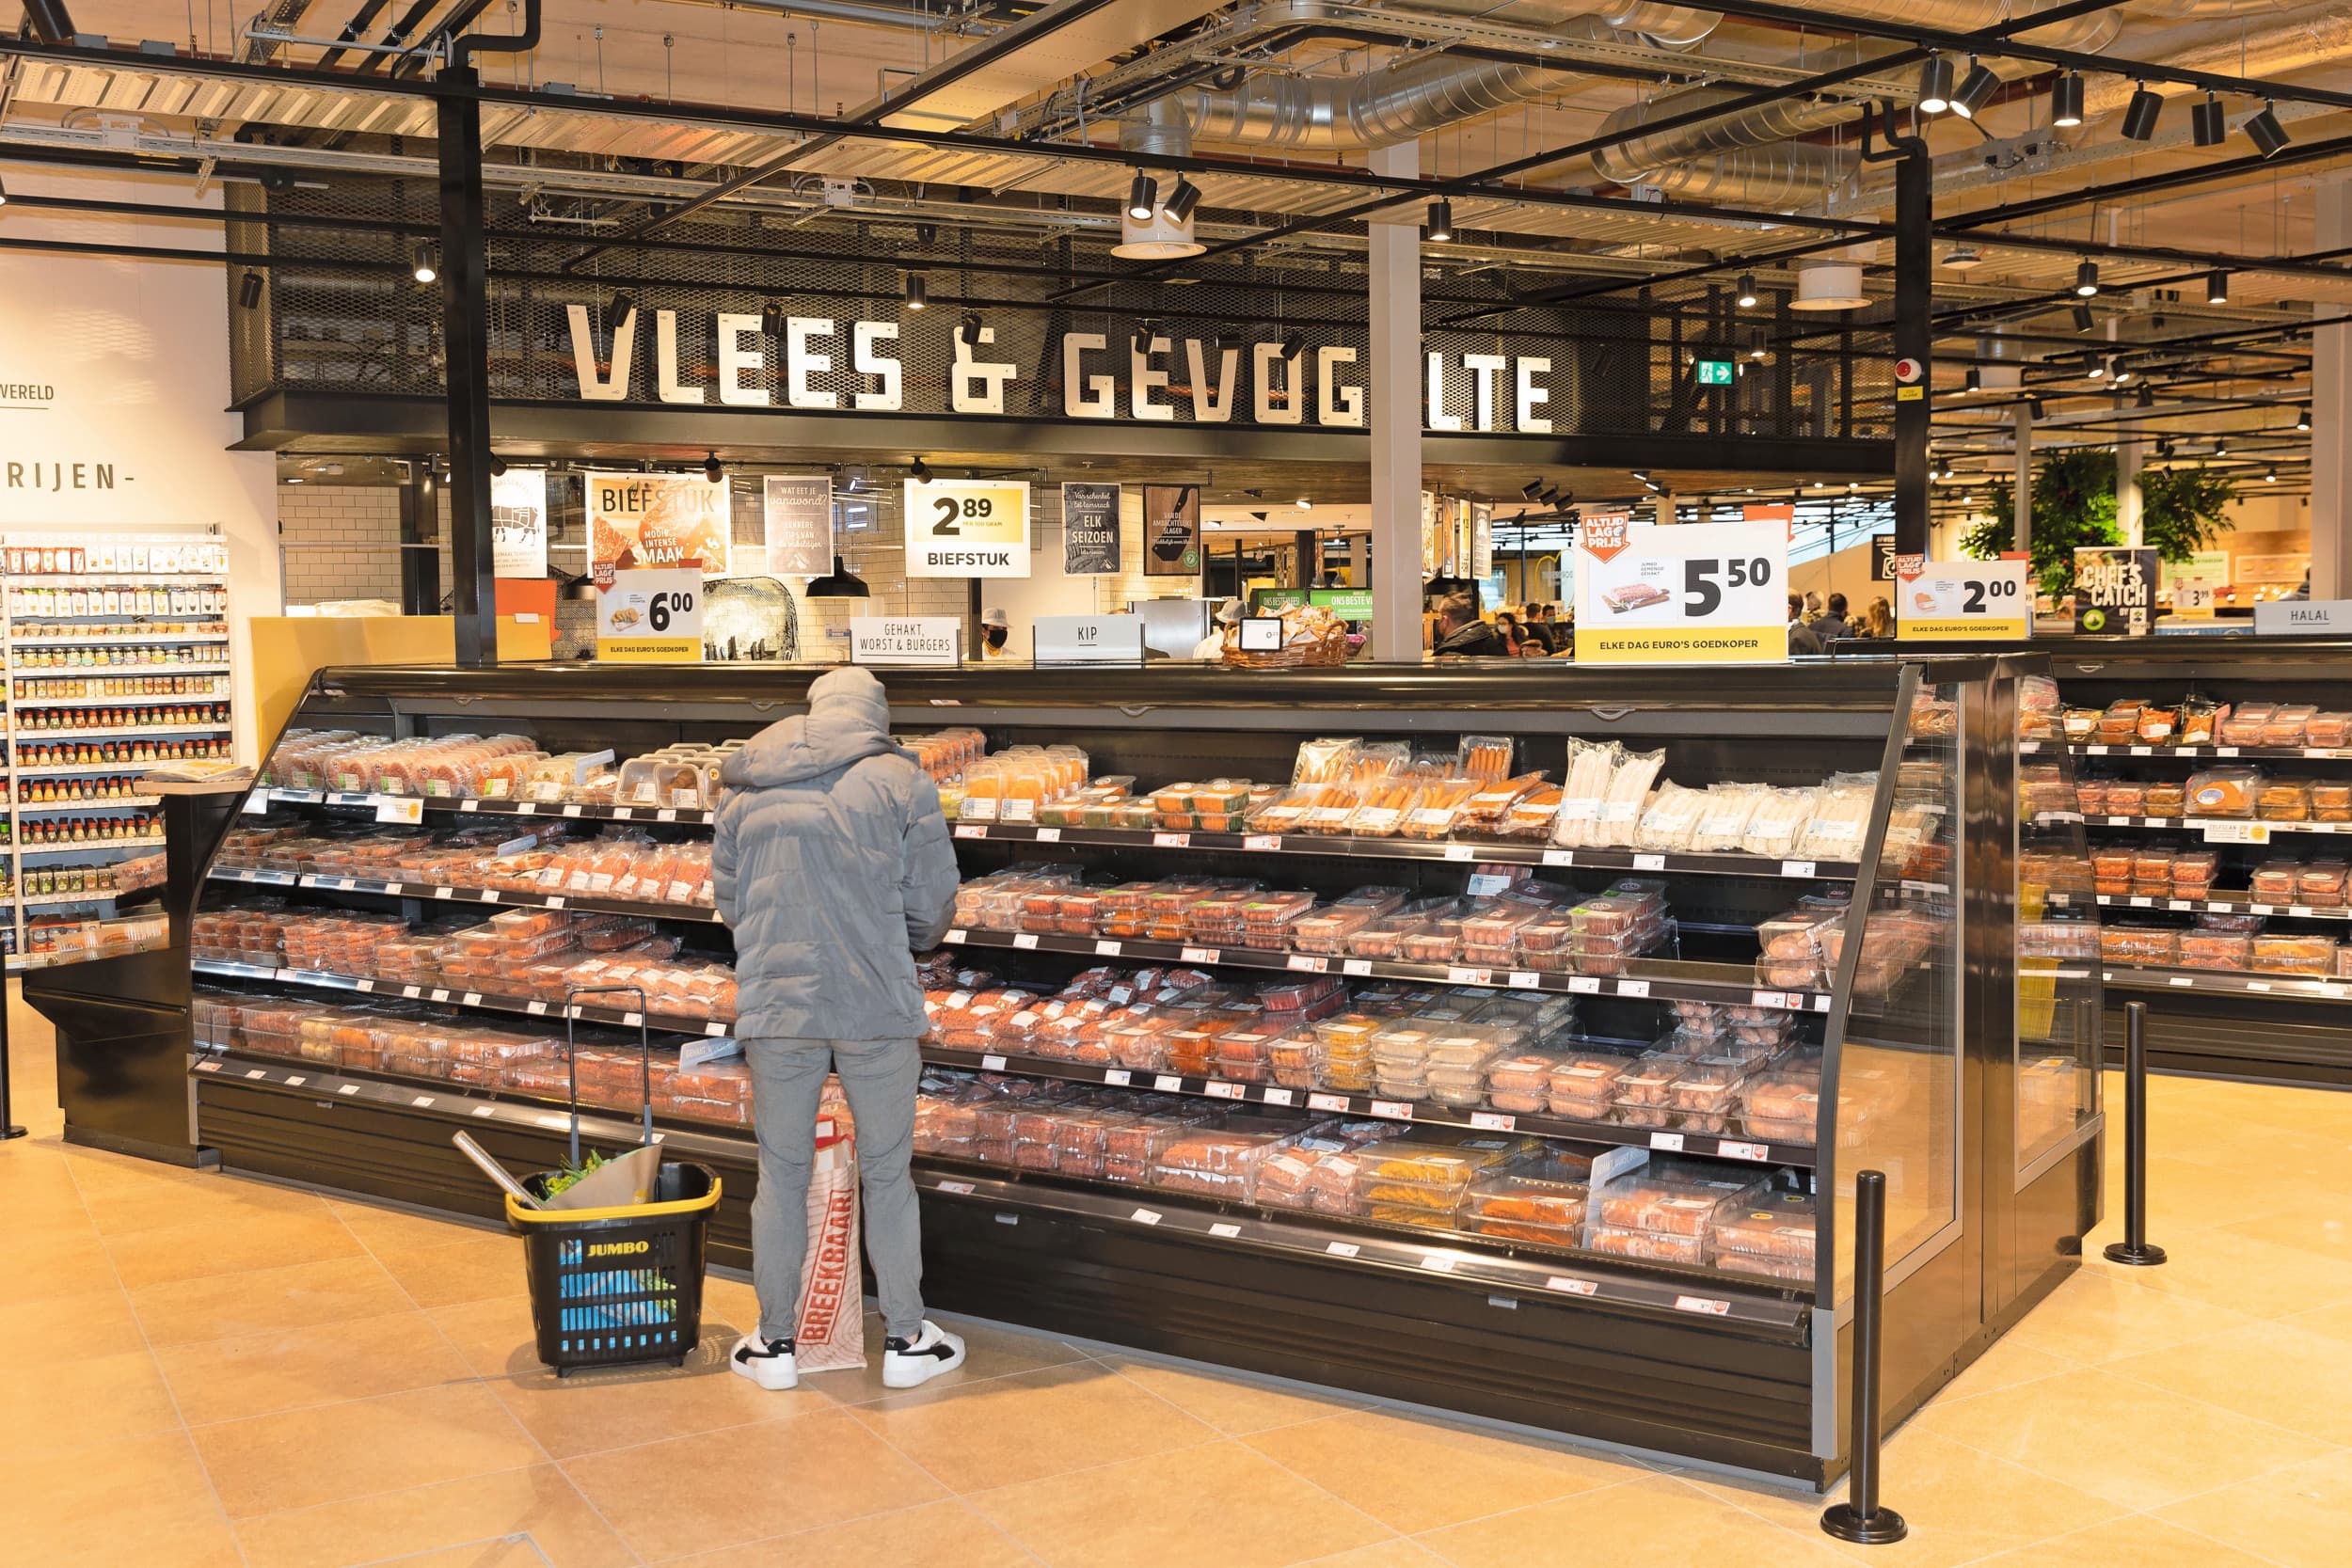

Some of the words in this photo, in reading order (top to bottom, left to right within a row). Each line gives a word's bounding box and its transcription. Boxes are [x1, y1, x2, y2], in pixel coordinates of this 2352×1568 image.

[566, 304, 901, 410] VLEES
[952, 326, 1017, 414] &
[602, 488, 715, 513] BIEFSTUK
[1084, 515, 1102, 528] ELK
[1585, 516, 1625, 527] ALTIJD
[645, 538, 677, 547] INTENSE
[1072, 531, 1114, 544] SEIZOEN
[1587, 536, 1622, 547] PRIJS
[633, 546, 684, 565] SMAAK
[928, 552, 1009, 566] BIEFSTUK
[2082, 562, 2142, 589] CHEF'S
[2091, 583, 2148, 607] CATCH
[2290, 610, 2329, 621] HALAL
[884, 623, 925, 637] GEHAKT,
[1077, 626, 1098, 641] KIP
[860, 638, 893, 651] WORST
[897, 639, 902, 651] &
[907, 639, 950, 652] BURGERS
[1599, 641, 1625, 650] ELKE
[1628, 641, 1649, 649] DAG
[1652, 641, 1690, 649] EURO'S
[1692, 639, 1758, 649] GOEDKOPER
[587, 1241, 649, 1258] JUMBO
[801, 1190, 852, 1340] BREEKBAAR
